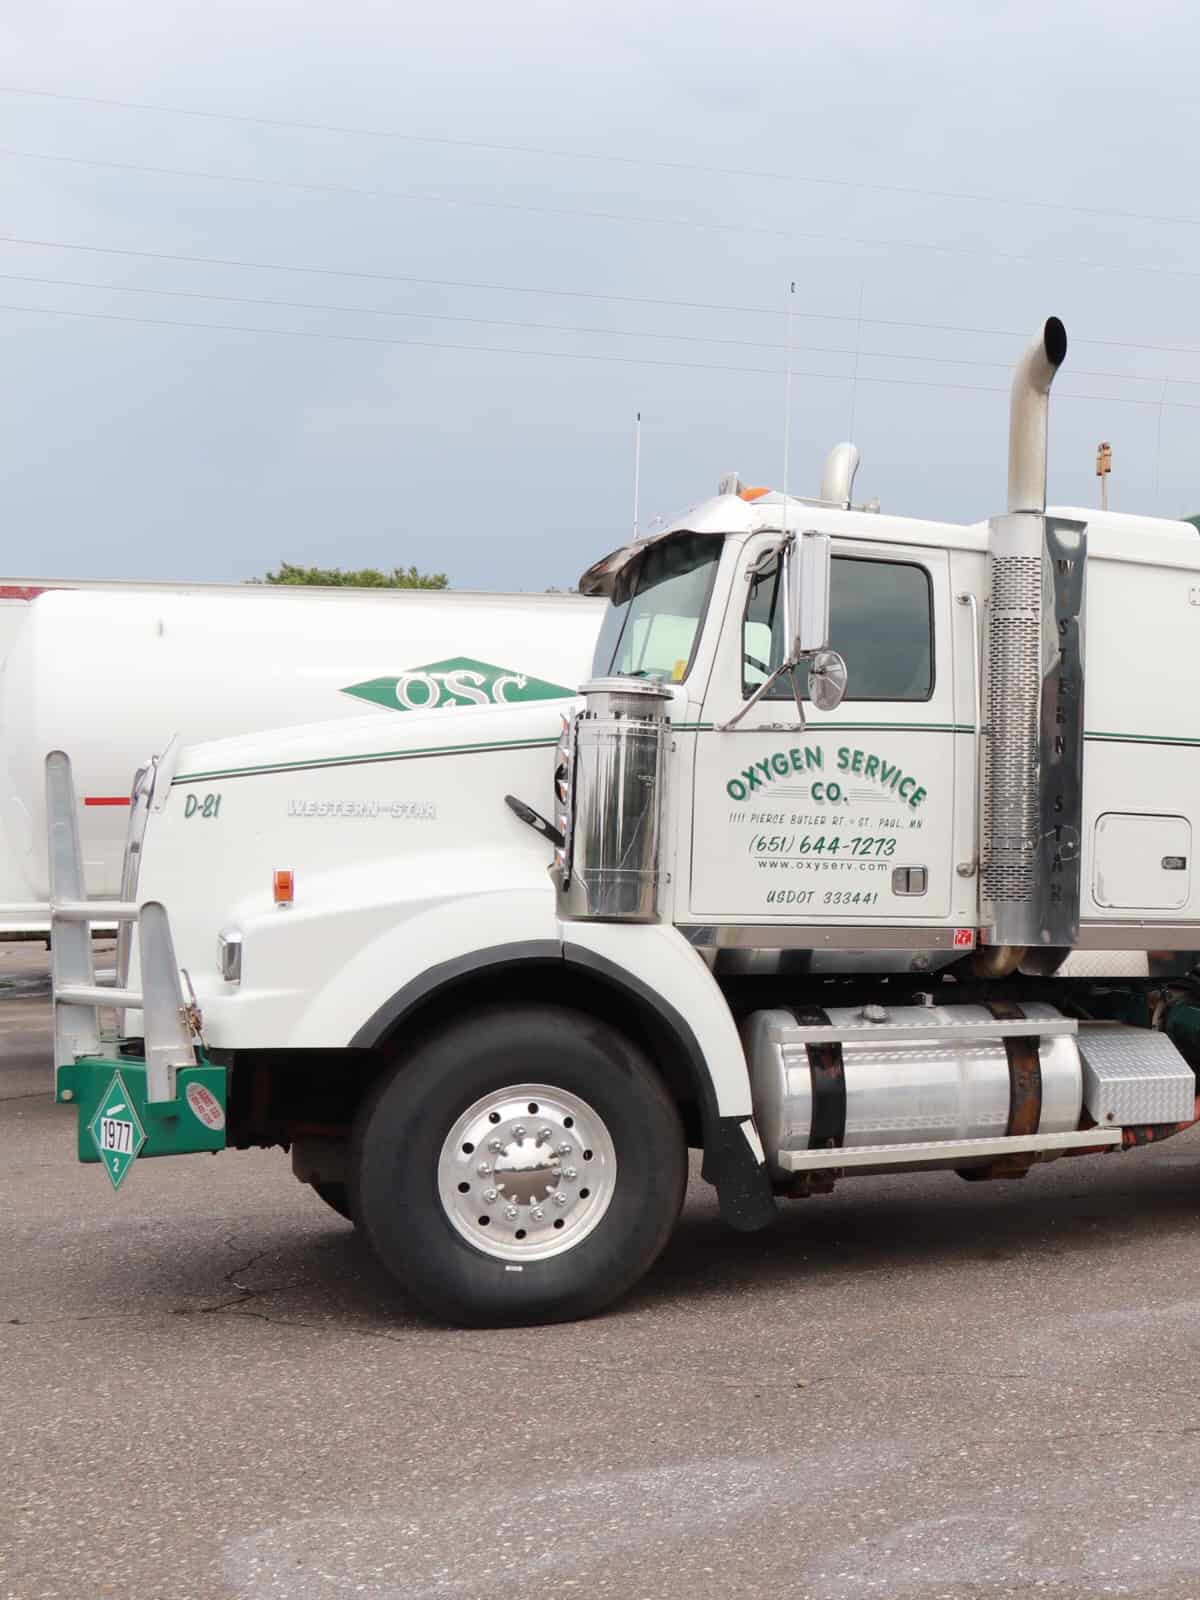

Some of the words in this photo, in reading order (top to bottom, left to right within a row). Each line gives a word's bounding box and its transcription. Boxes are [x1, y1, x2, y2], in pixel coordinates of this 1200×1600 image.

[726, 745, 824, 802] OXYGEN
[836, 747, 928, 809] SERVICE
[810, 781, 849, 803] CO.
[184, 792, 222, 818] D-81
[391, 800, 437, 818] STAR
[728, 812, 746, 824] 1111
[750, 813, 785, 825] PIERCE
[790, 814, 827, 826] BUTLER
[909, 819, 923, 829] MN
[748, 833, 796, 854] (651)
[799, 835, 897, 857] 644-7273
[757, 860, 888, 872] www.oxyserv.com
[766, 890, 816, 905] USDOT
[823, 891, 880, 905] 333441
[103, 1120, 131, 1152] 1977
[112, 1157, 120, 1173] 2
